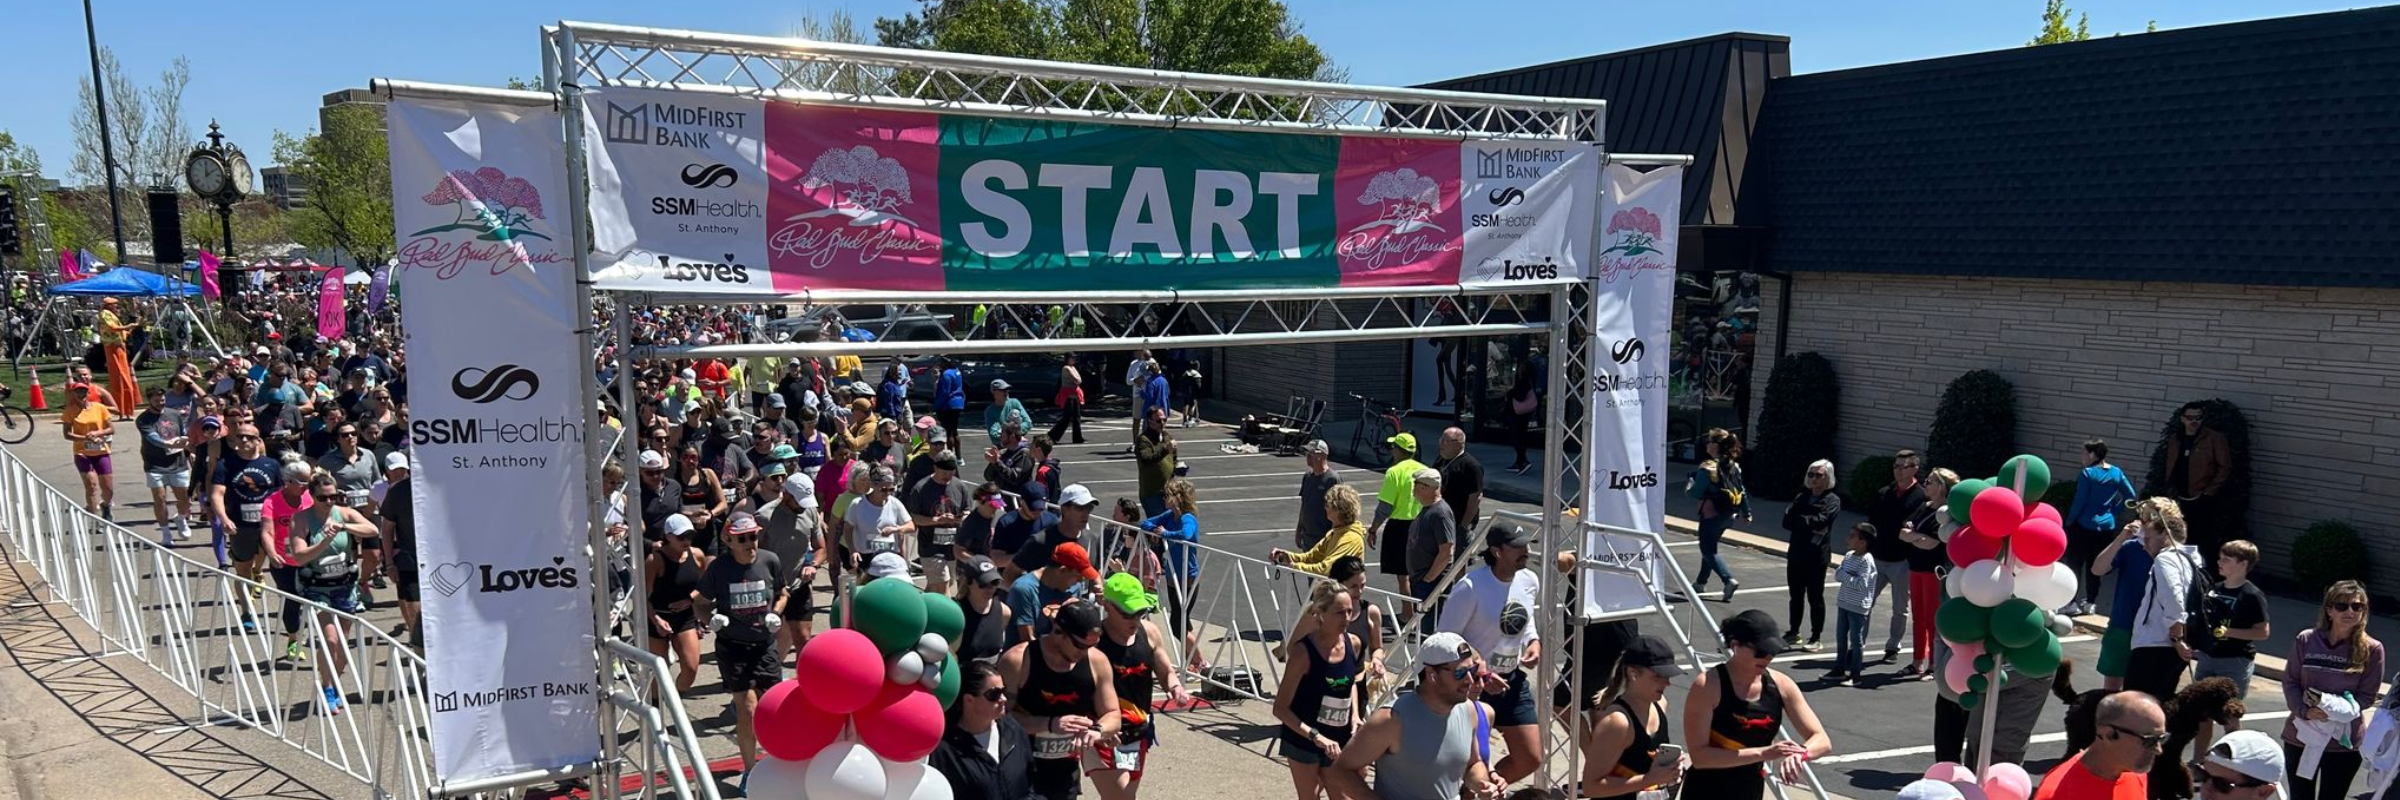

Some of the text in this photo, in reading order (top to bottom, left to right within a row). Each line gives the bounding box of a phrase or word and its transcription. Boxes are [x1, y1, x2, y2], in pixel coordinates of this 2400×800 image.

[655, 103, 746, 129] MIDFIRST
[656, 127, 711, 149] BANK
[1506, 164, 1542, 179] BANK
[959, 159, 1320, 259] START
[678, 223, 740, 236] St. Anthony
[398, 236, 574, 280] Red Bud Classic
[769, 221, 935, 270] Red Bud Classic
[1338, 232, 1459, 271] Red Bud Classic
[452, 455, 548, 469] St. Anthony
[735, 592, 763, 605] 1036
[463, 682, 590, 708] MIDFIRST BANK
